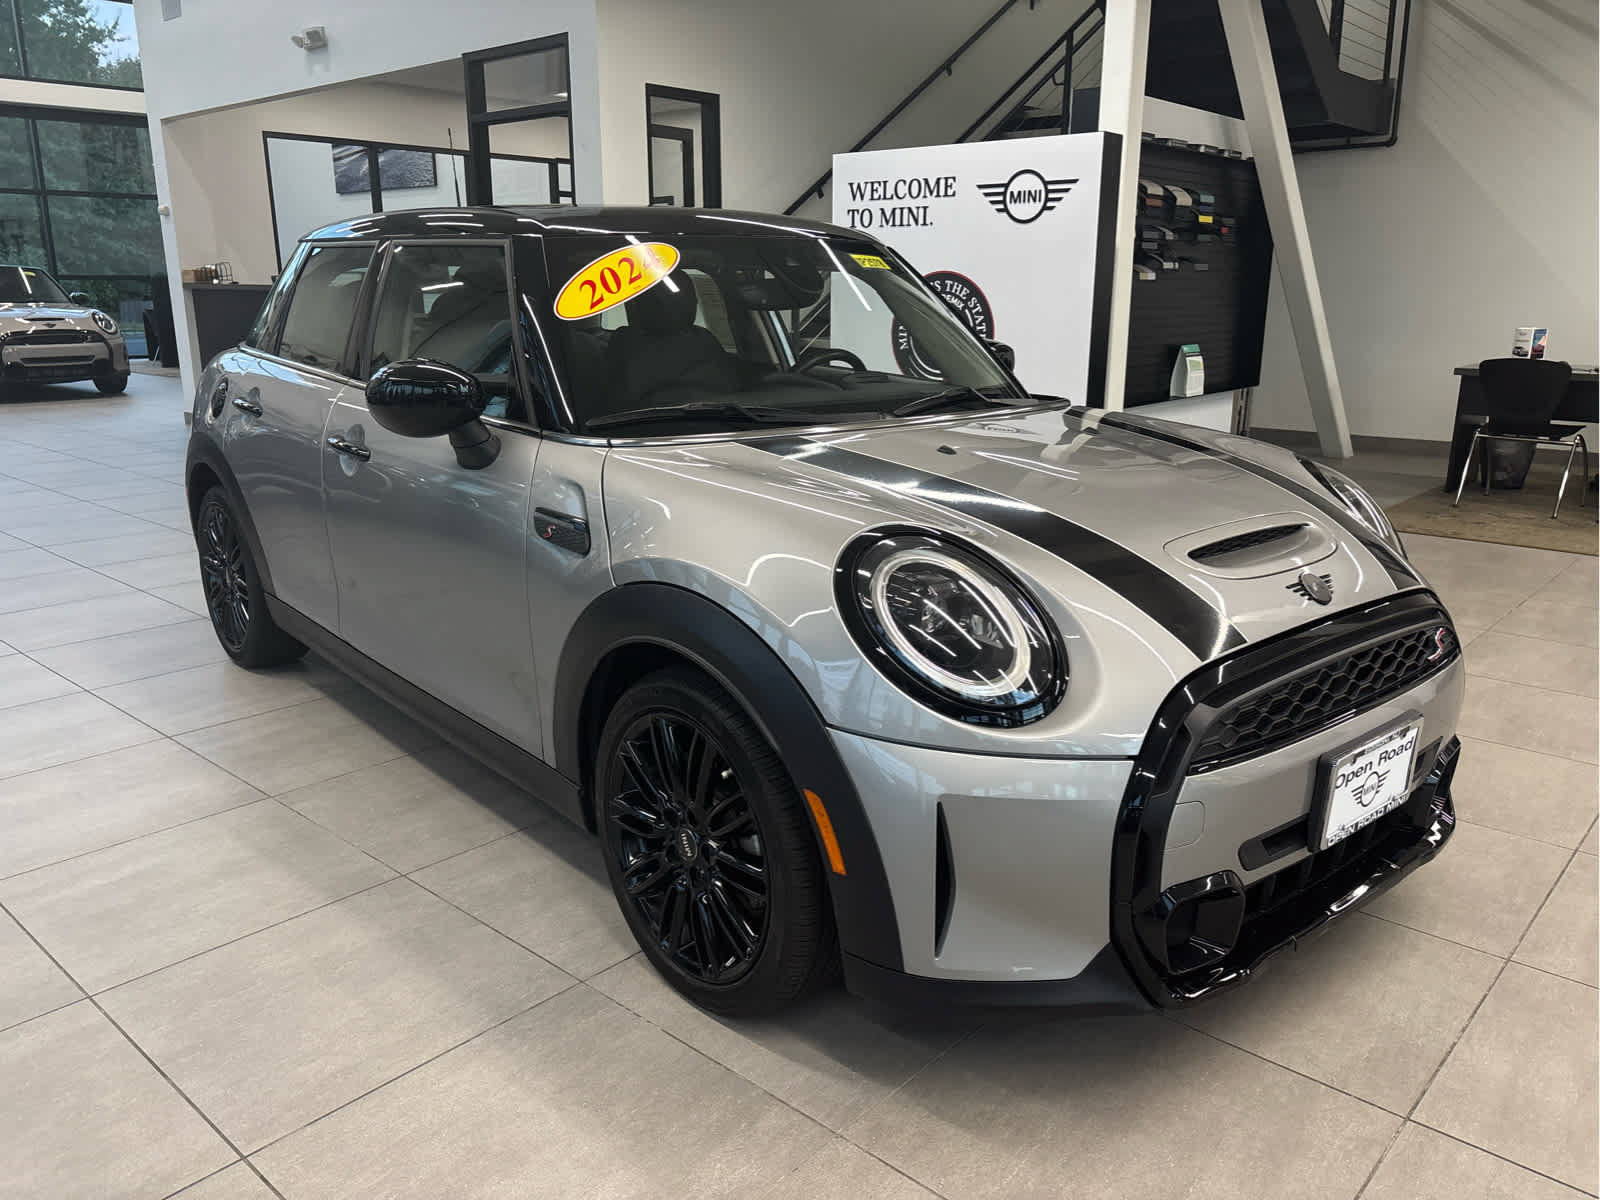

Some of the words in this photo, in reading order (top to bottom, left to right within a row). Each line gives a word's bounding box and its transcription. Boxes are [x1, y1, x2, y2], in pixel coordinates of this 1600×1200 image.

[848, 176, 957, 201] WELCOME
[1009, 189, 1042, 204] MINI
[847, 208, 873, 228] TO
[879, 206, 934, 228] MINI.
[944, 280, 970, 300] THE
[1335, 761, 1373, 789] Open
[1377, 735, 1415, 767] Road
